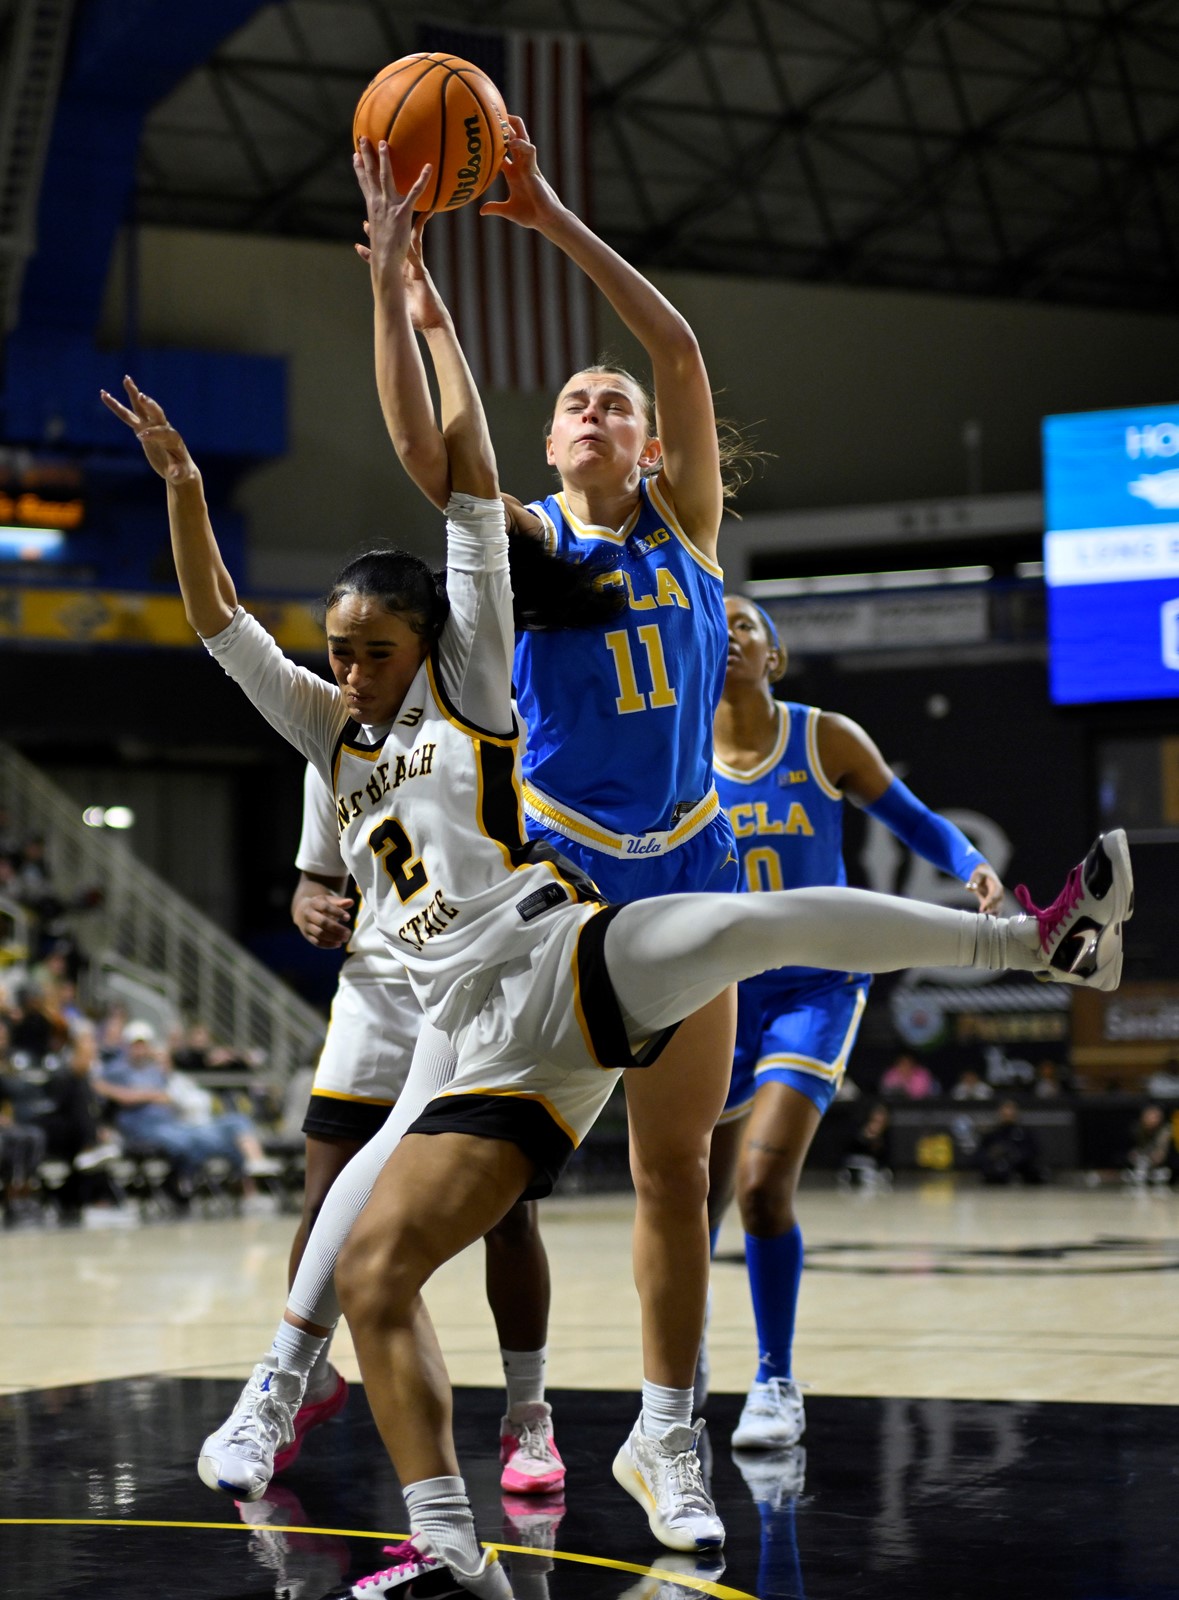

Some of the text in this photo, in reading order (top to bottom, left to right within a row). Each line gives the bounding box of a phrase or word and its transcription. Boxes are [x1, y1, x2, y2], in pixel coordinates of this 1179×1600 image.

[445, 115, 481, 207] Wilson
[592, 567, 691, 611] CLA
[604, 623, 678, 715] 11
[366, 743, 437, 806] BEACH
[626, 837, 662, 855] Ucla
[727, 802, 815, 839] CLA
[368, 816, 430, 906] 2
[398, 889, 460, 952] STATE
